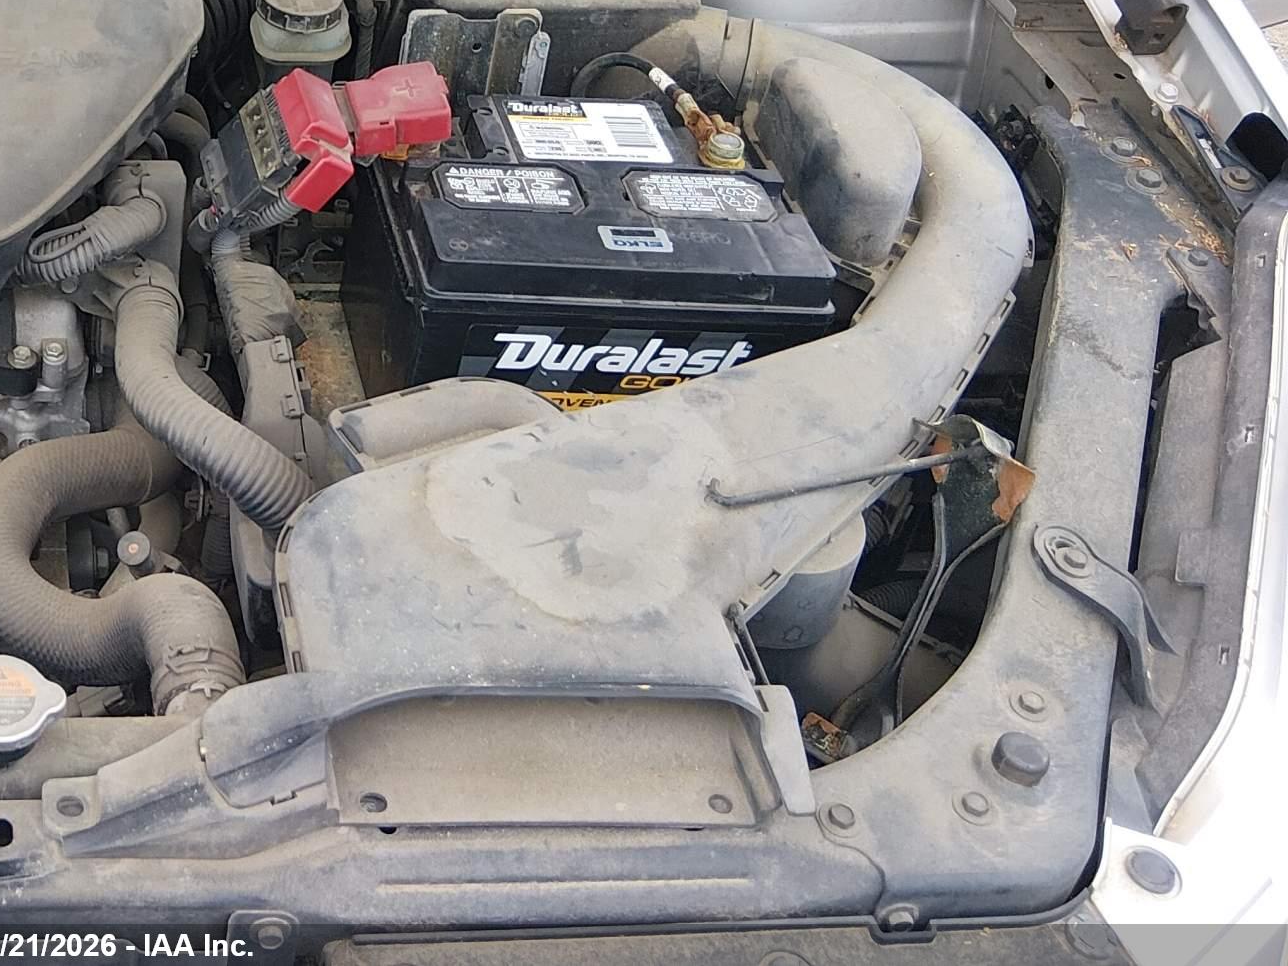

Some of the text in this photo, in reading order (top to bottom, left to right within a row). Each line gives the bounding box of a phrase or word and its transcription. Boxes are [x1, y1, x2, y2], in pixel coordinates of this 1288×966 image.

[507, 102, 580, 115] Duralast
[458, 167, 505, 176] DANGER
[513, 169, 556, 178] POISON
[493, 332, 752, 375] Duralast
